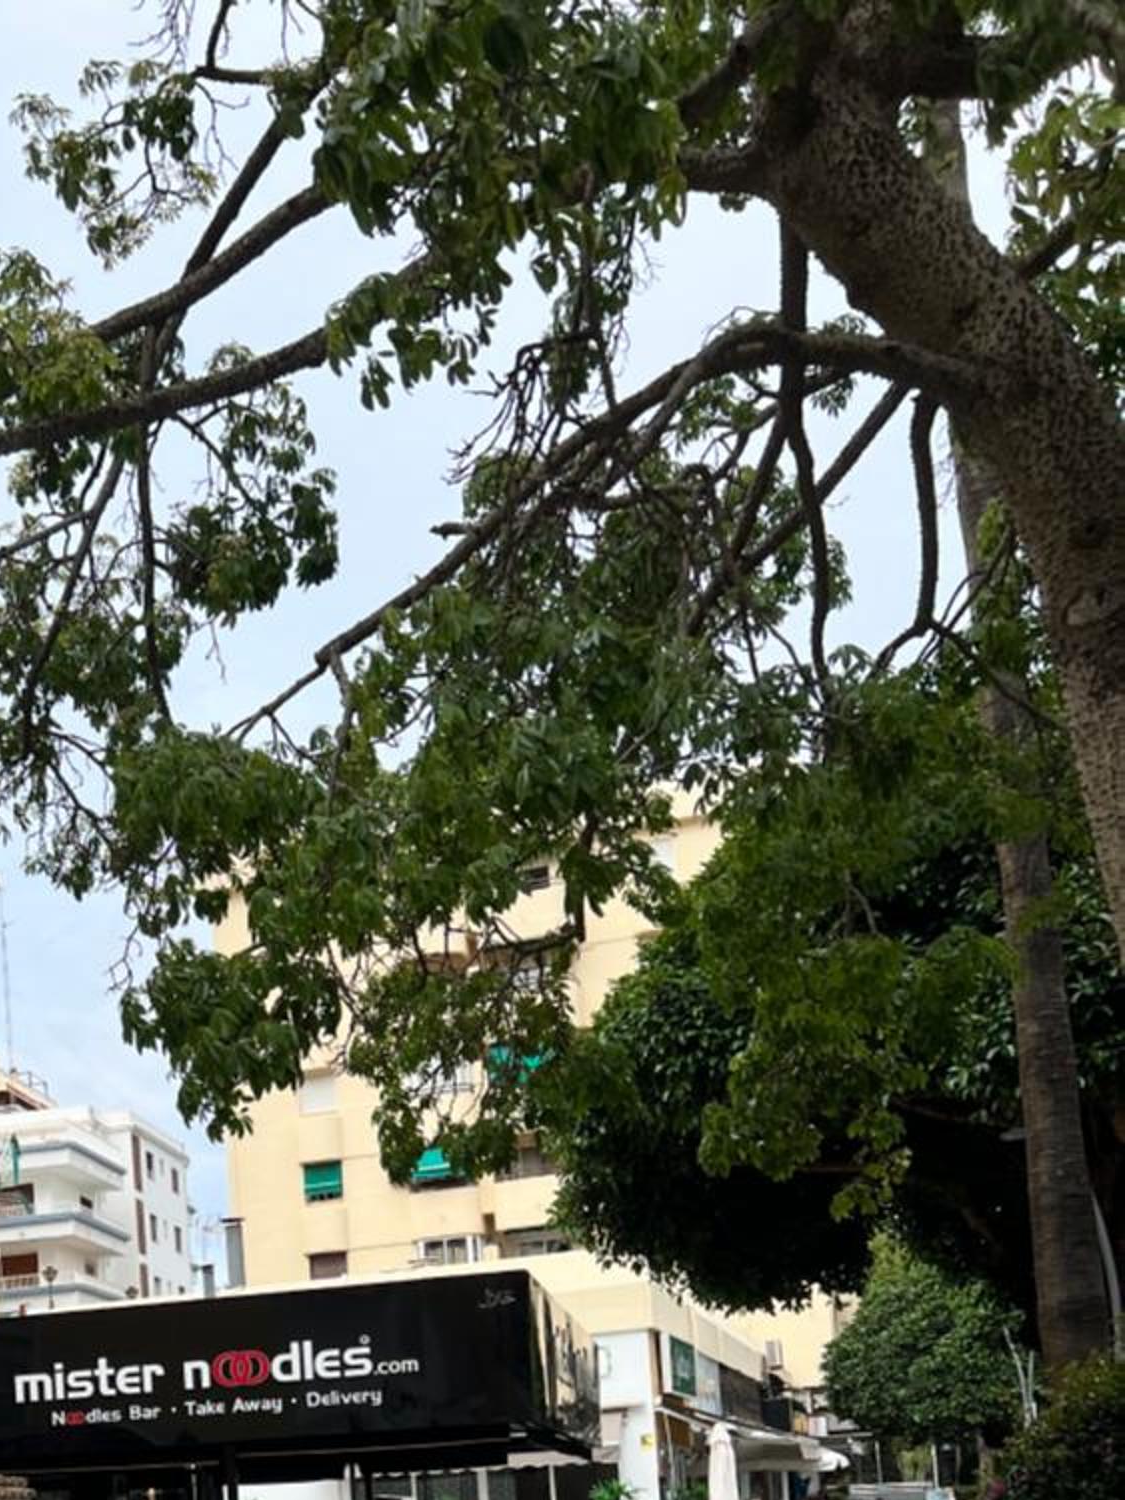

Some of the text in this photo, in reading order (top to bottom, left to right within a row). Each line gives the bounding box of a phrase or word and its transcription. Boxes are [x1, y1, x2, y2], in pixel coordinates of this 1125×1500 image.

[14, 1356, 166, 1404] mister
[129, 1404, 162, 1421] Bar
[184, 1400, 225, 1416] Take
[232, 1397, 283, 1415] Away
[305, 1389, 383, 1408] Delivery
